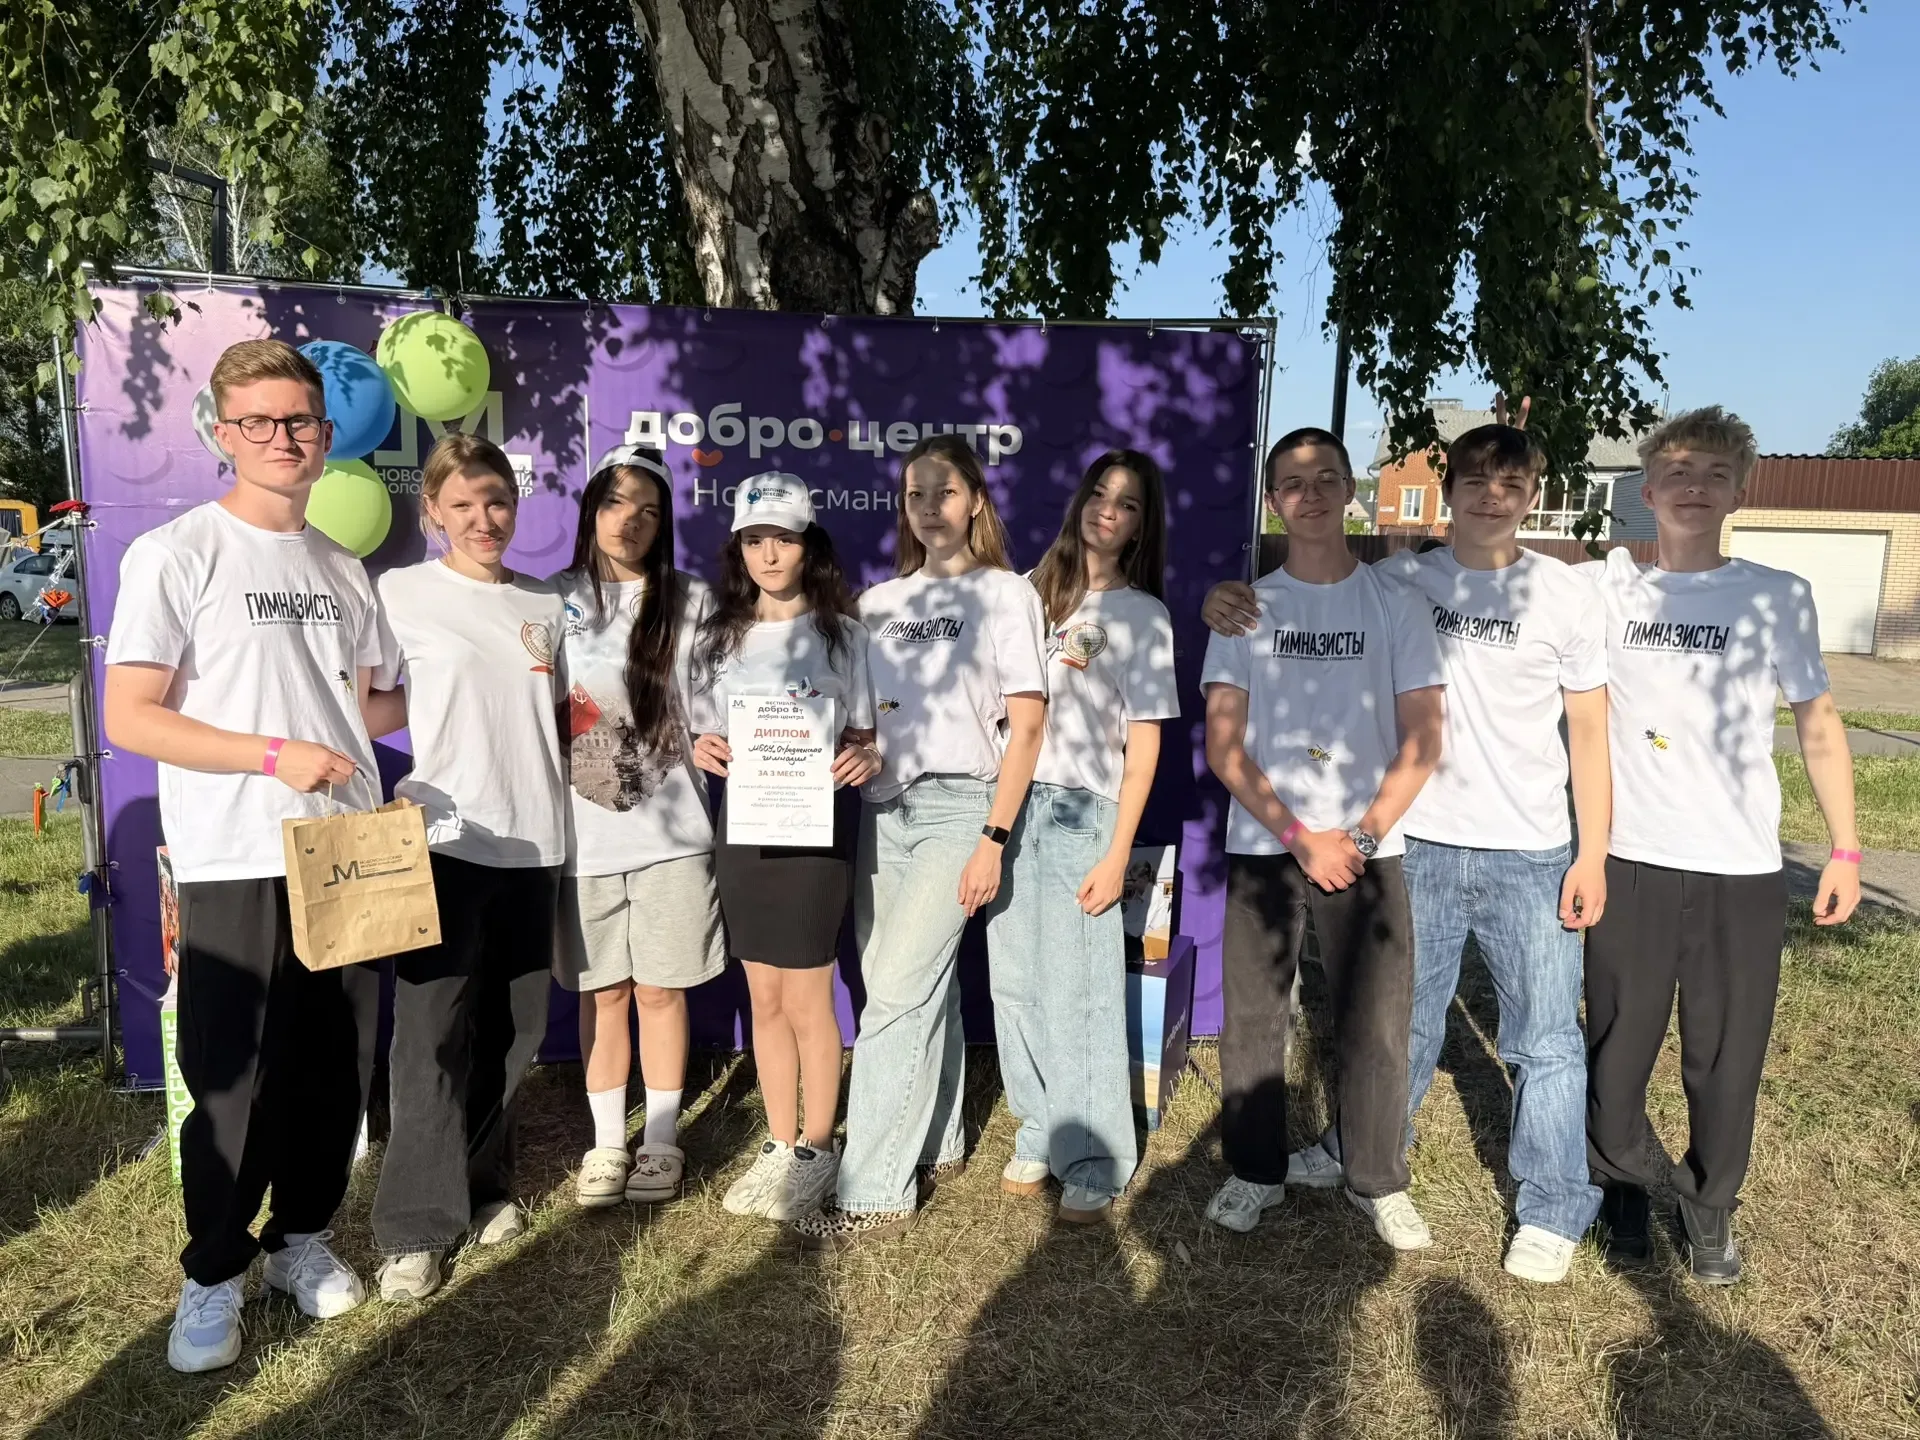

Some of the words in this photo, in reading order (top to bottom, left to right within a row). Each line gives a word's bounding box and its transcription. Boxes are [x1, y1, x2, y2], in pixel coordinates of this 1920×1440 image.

[244, 592, 344, 622] ГИМНАЗИСТЫ
[881, 617, 965, 640] ГИМНАЗИСТЫ
[1432, 605, 1521, 646] ГИМНАЗИСТЫ
[1623, 620, 1731, 651] ГИМНАЗИСТЫ
[1273, 629, 1365, 656] ГИМНАЗИСТЫ
[757, 705, 789, 714] добро
[753, 728, 810, 739] ДИПЛОМ
